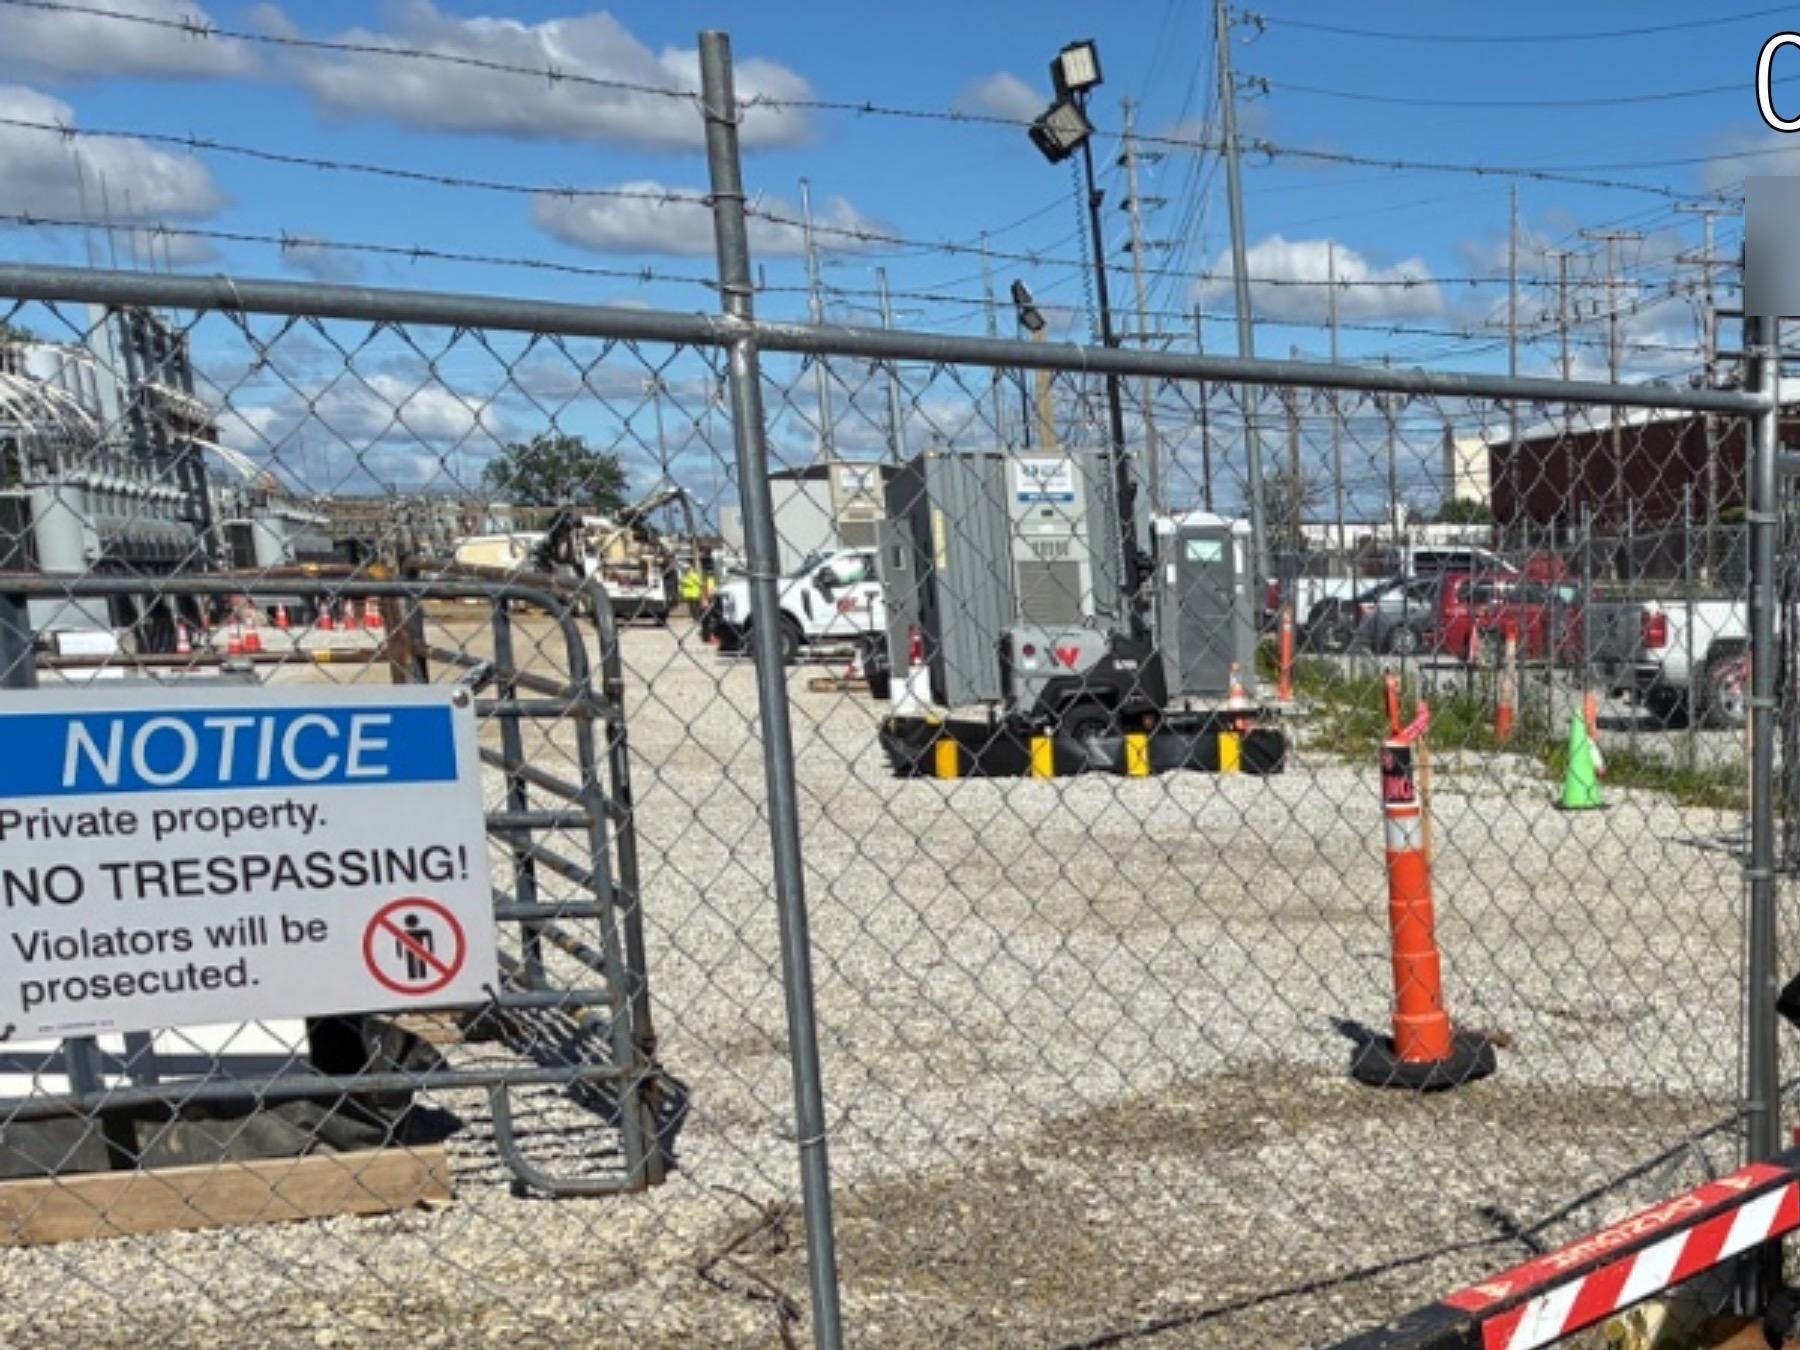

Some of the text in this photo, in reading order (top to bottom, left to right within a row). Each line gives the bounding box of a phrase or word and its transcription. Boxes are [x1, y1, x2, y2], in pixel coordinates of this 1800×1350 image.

[62, 713, 393, 788] NOTICE
[0, 799, 328, 841] Private property.
[2, 845, 470, 907] NO TRESPASSING!
[12, 914, 329, 963] Violators will be
[19, 958, 260, 1011] prosecuted.
